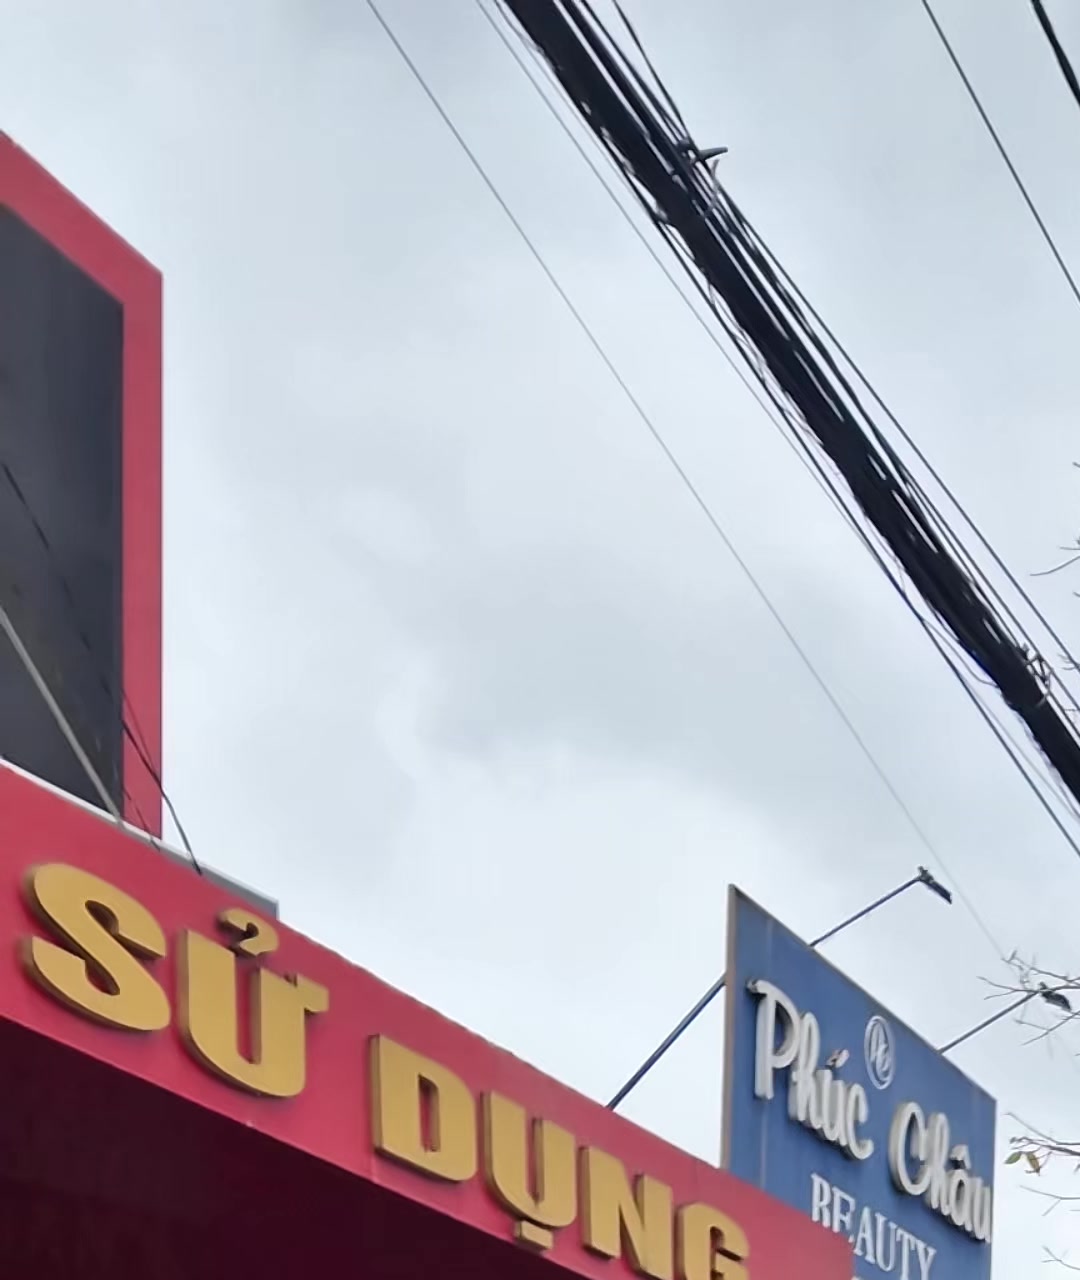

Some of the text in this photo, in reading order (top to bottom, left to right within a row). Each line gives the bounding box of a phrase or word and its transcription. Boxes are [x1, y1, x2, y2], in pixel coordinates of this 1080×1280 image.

[20, 862, 330, 1098] SỬ
[747, 977, 992, 1243] Phúc Châu
